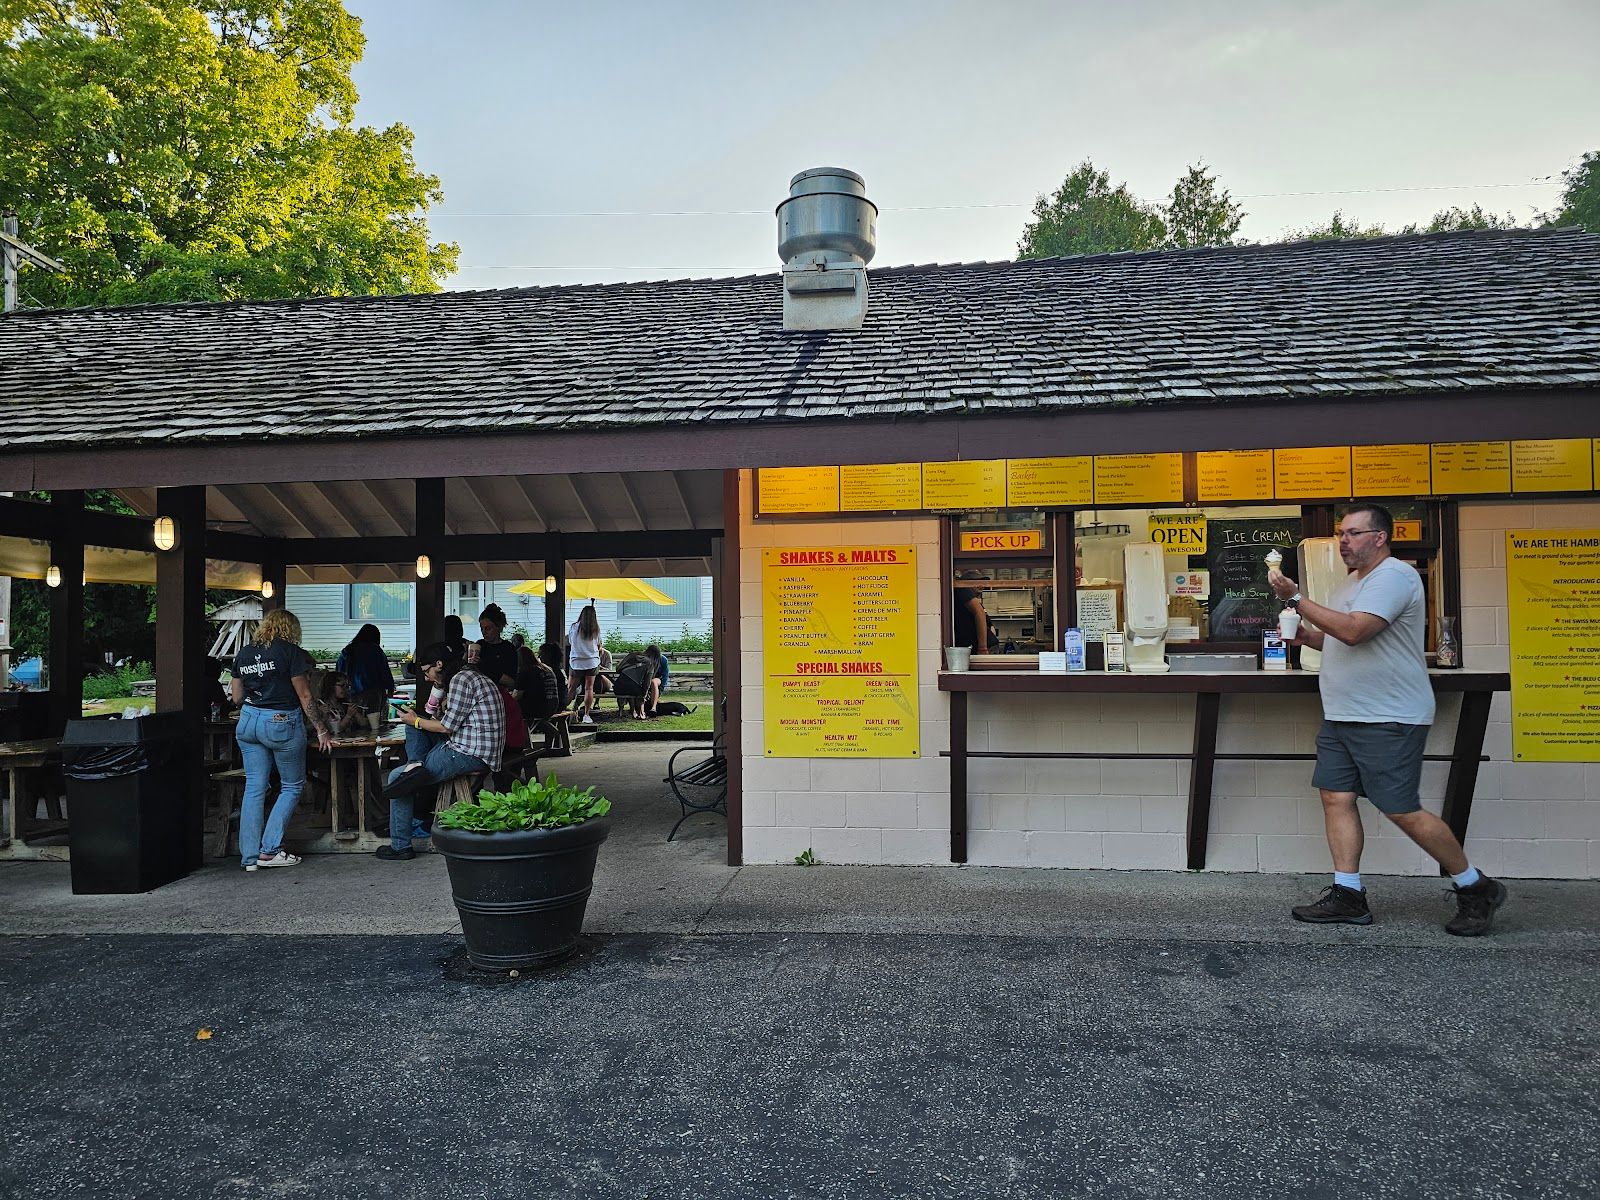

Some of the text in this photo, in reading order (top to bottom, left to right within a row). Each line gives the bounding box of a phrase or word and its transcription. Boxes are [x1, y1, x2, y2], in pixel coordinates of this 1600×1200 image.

[1156, 516, 1198, 524] WE ARE
[1152, 527, 1204, 544] OPEN
[1223, 529, 1292, 544] ICE CREAM
[971, 536, 1030, 548] PICK UP
[1513, 540, 1528, 548] WE
[1530, 539, 1548, 548] ARE
[1551, 539, 1568, 547] THE
[780, 550, 896, 564] SHAKES & MALTS
[1224, 588, 1245, 598] Hard
[239, 661, 275, 676] POSSIBLE
[796, 662, 882, 673] SPECIAL SHAKES
